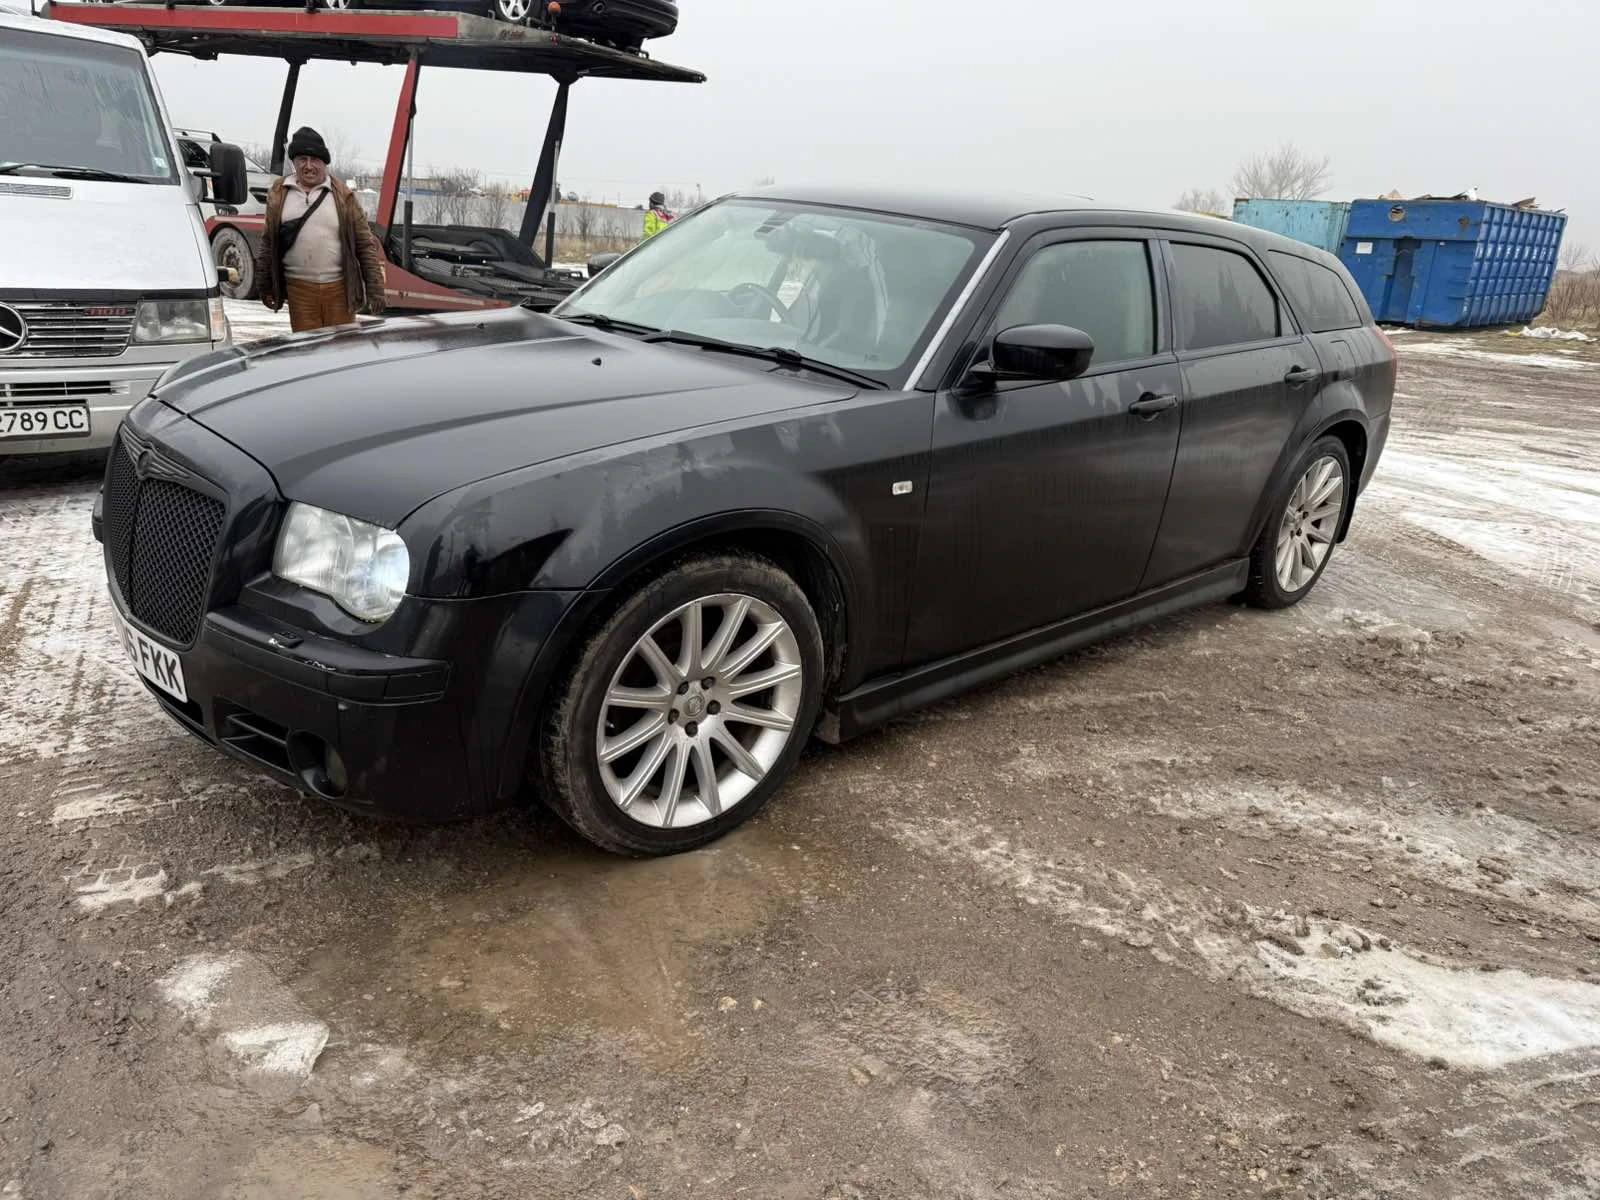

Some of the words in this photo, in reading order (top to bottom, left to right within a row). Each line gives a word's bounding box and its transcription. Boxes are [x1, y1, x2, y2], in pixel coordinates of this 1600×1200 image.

[0, 411, 48, 432] 789
[53, 409, 84, 430] CC
[137, 635, 184, 695] FKK
